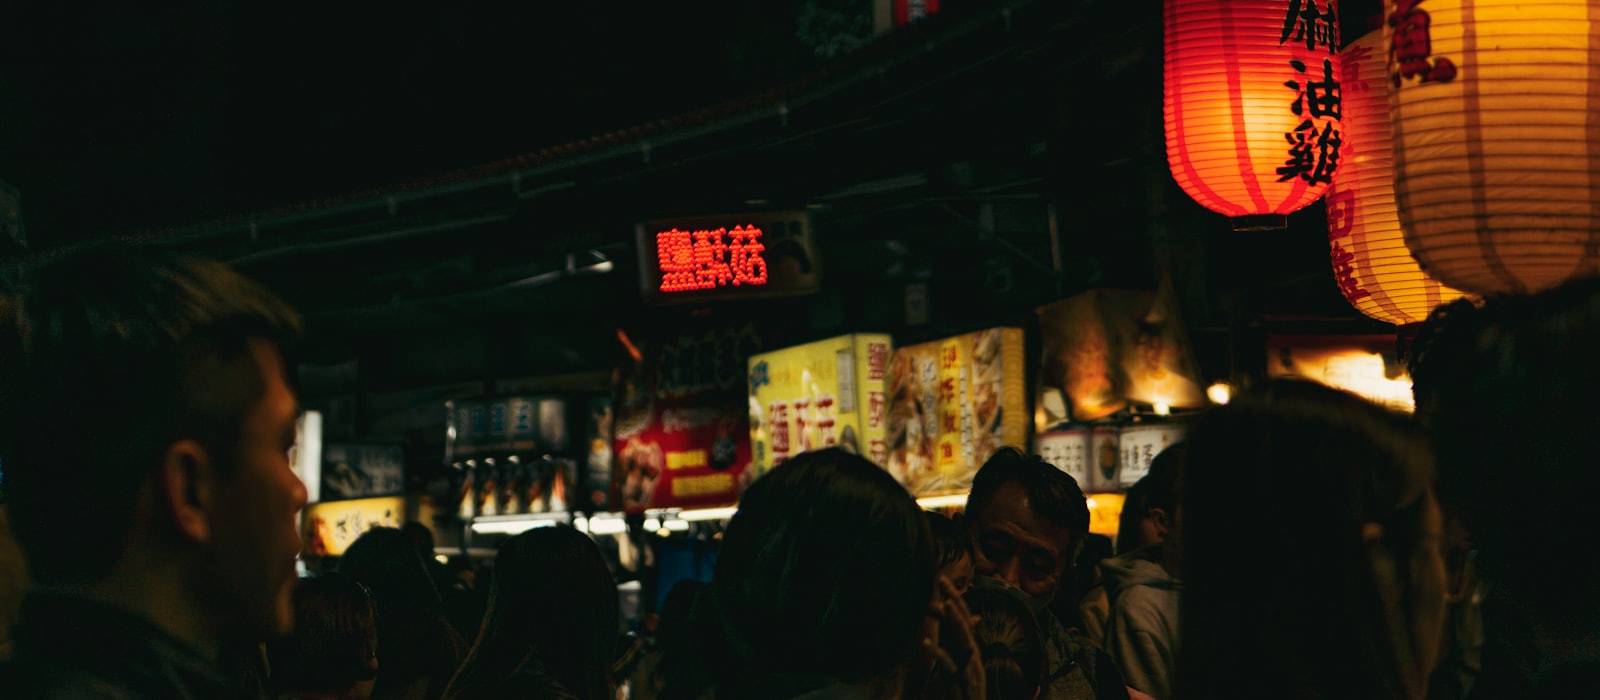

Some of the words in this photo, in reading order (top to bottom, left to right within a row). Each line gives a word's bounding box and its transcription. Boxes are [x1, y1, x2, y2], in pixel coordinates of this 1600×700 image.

[1278, 0, 1342, 187] 麻油雞
[656, 223, 769, 293] 鹽酥菇
